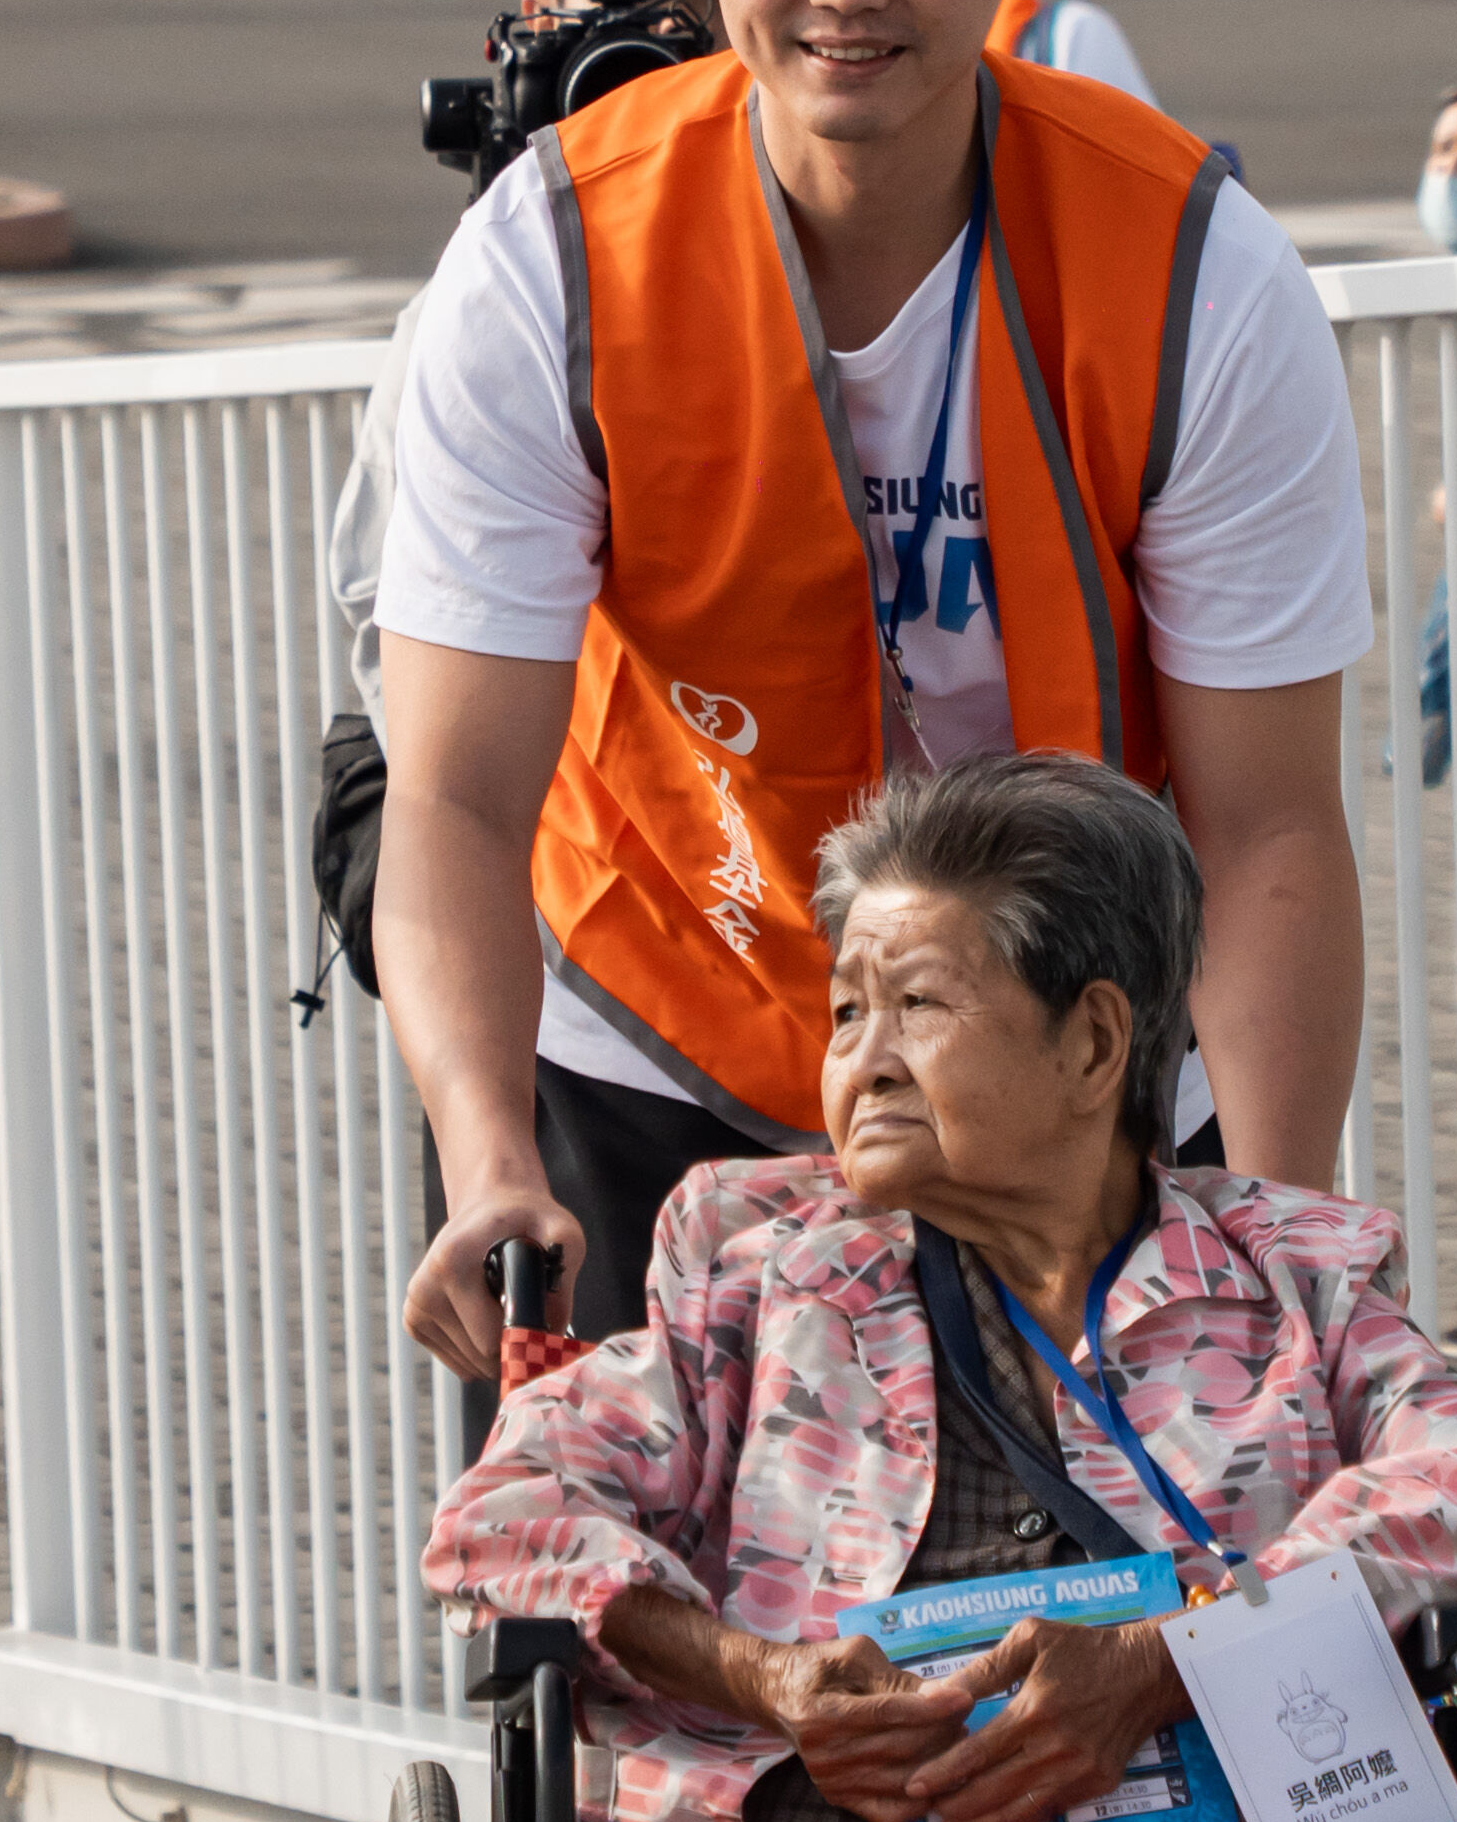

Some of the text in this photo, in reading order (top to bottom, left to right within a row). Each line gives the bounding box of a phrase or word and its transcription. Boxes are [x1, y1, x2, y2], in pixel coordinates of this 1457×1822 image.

[902, 1571, 1140, 1629] KAOHSIUNG AQUAS
[1287, 1749, 1398, 1813] 吳綢阿嬤
[1372, 1791, 1381, 1804] a
[1384, 1780, 1409, 1798] ma
